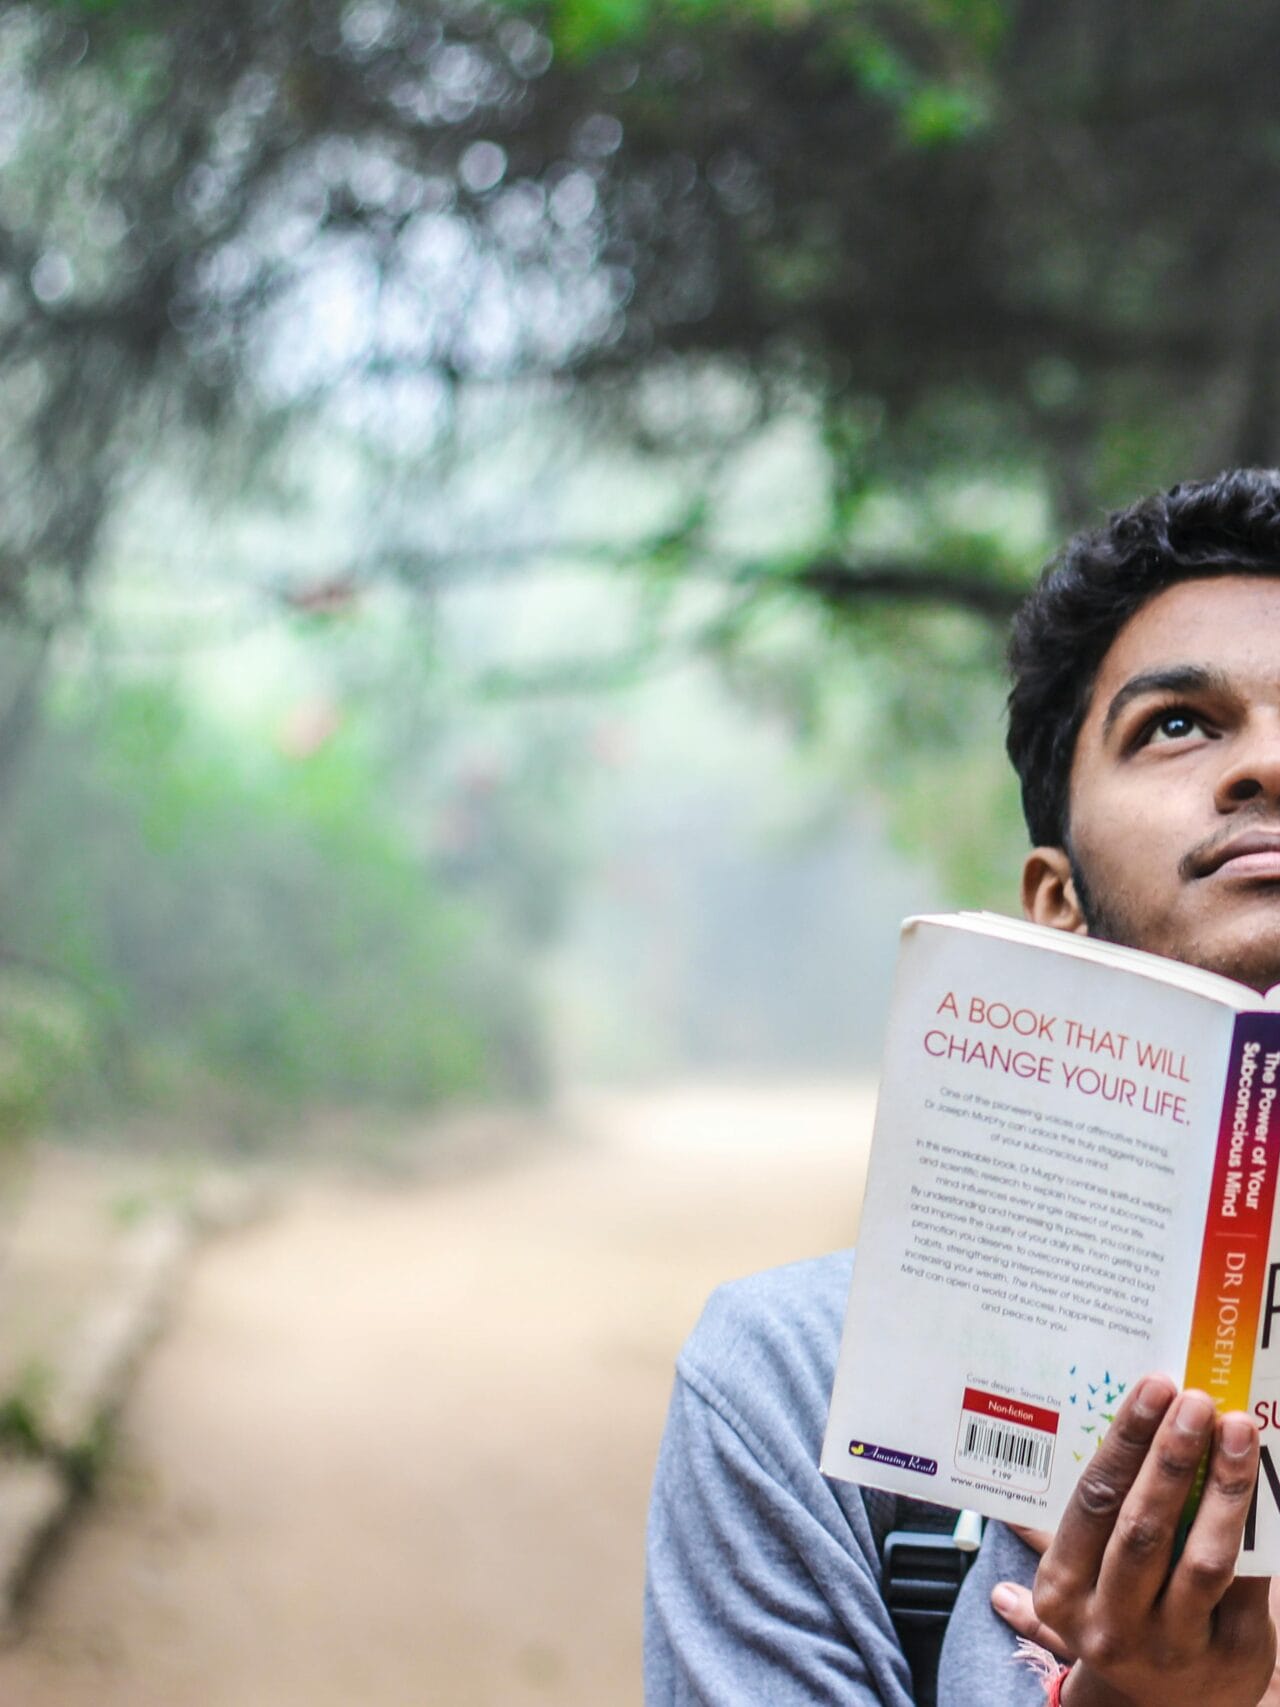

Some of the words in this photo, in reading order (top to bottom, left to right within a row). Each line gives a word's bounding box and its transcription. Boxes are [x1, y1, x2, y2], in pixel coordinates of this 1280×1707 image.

[936, 991, 958, 1018] A
[968, 996, 1056, 1042] BOOK
[1065, 1020, 1128, 1060] THAT
[1136, 1040, 1190, 1082] WILL
[923, 1029, 1053, 1083] CHANGE
[1062, 1062, 1136, 1106] YOUR
[1142, 1086, 1189, 1125] LIFE.
[1227, 1041, 1262, 1168] Subconscious
[1254, 1087, 1277, 1143] Power
[1251, 1146, 1268, 1167] of
[1221, 1170, 1243, 1218] Mind
[1245, 1168, 1266, 1210] Your
[1222, 1251, 1247, 1288] DR
[1209, 1295, 1240, 1386] JOSEPH
[988, 1400, 1034, 1422] Non-fiction
[866, 1446, 906, 1469] Amazing
[908, 1455, 936, 1474] Reads
[950, 1476, 1048, 1507] www.amazingreads.in
